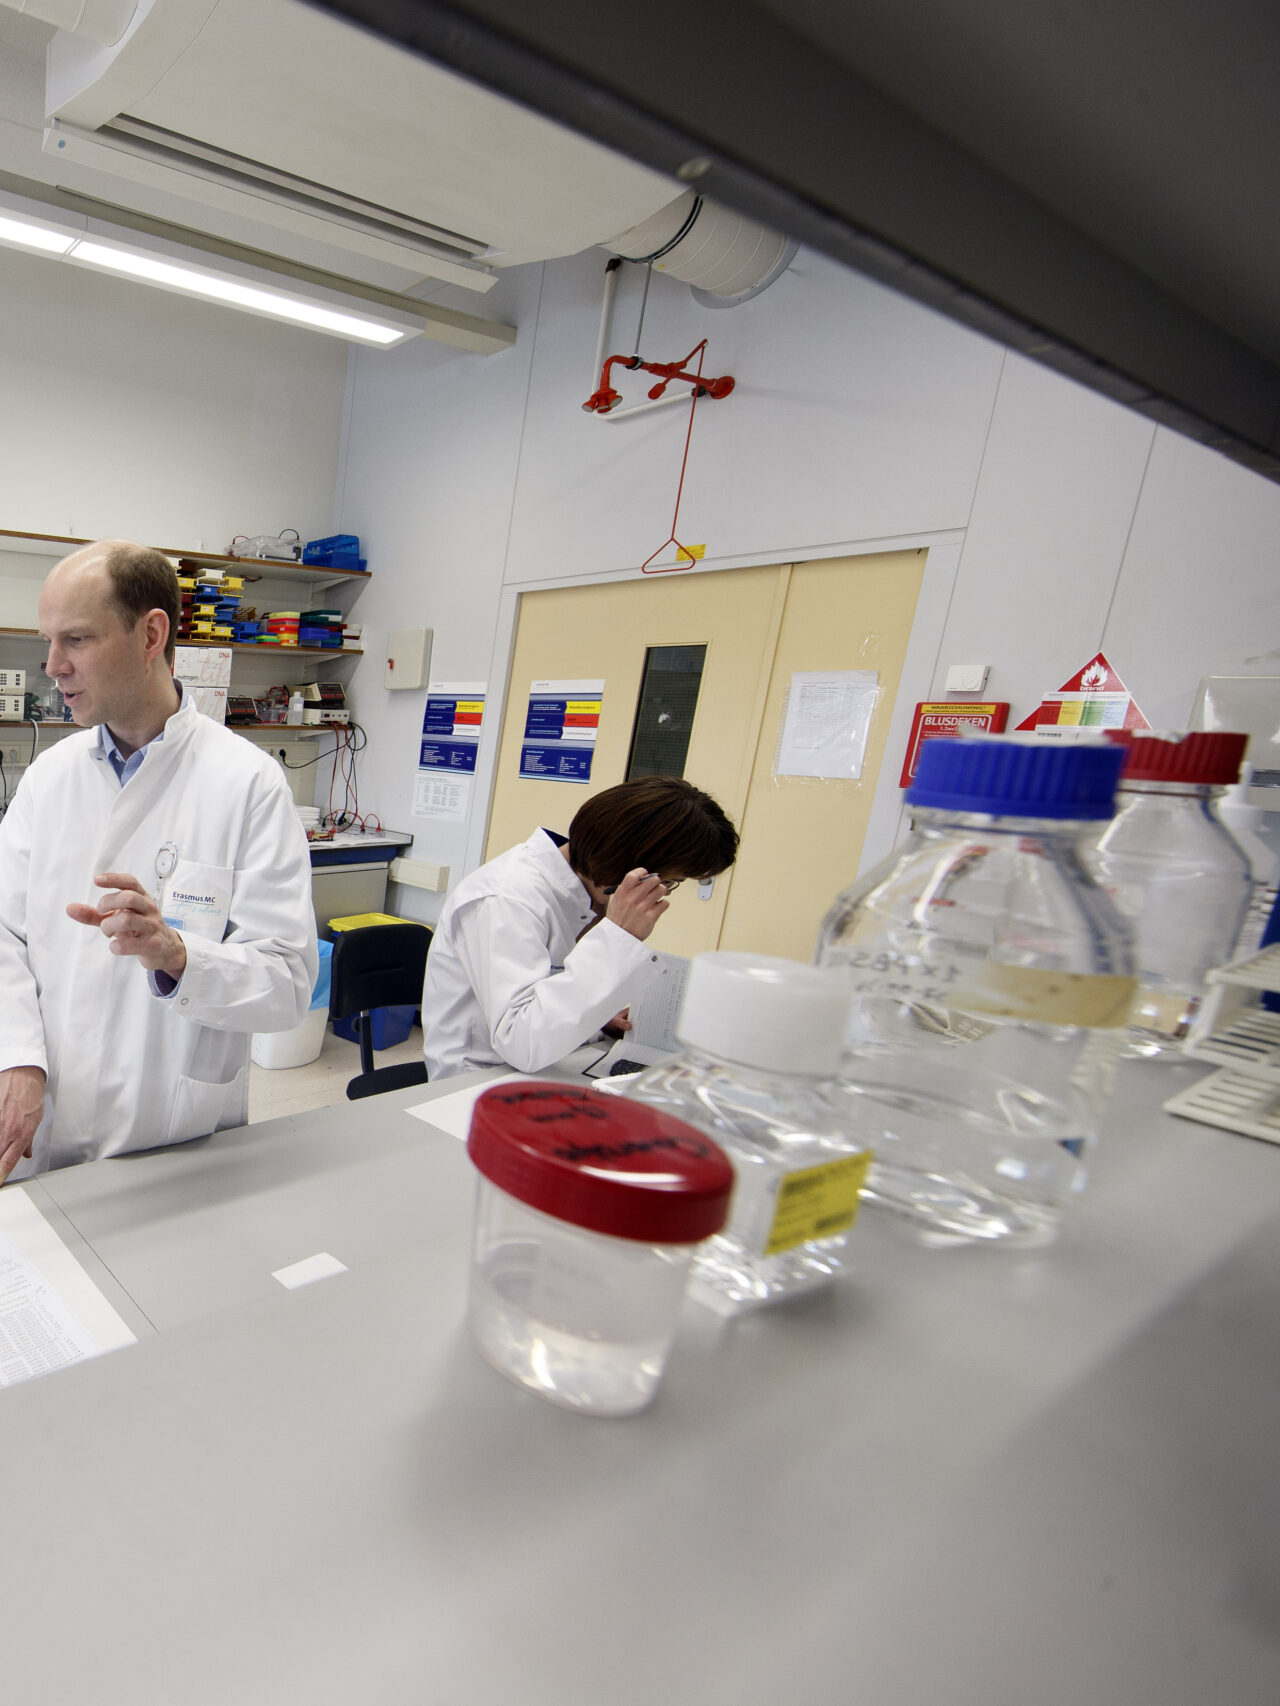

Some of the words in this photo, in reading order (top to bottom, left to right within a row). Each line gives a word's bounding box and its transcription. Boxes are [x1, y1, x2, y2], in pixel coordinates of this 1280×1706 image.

[924, 716, 987, 727] BLUSDEKEN
[172, 891, 204, 902] Erasmus
[204, 896, 216, 904] MC
